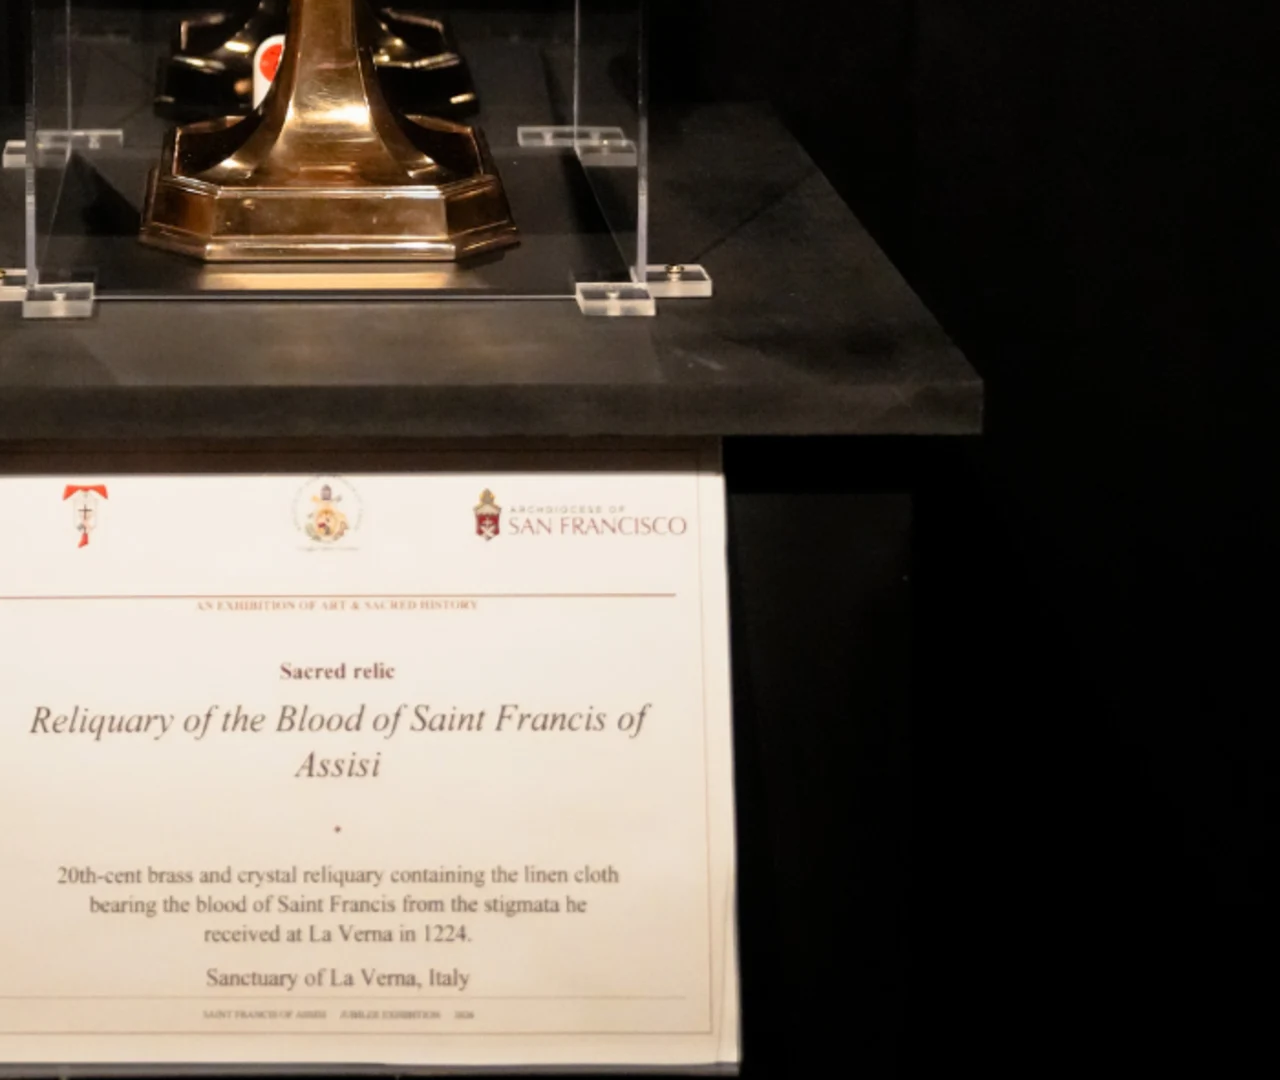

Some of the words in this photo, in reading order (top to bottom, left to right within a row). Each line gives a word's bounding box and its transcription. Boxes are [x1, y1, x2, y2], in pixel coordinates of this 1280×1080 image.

[508, 504, 603, 515] ARCHDIOCESE
[608, 504, 627, 515] OF
[508, 516, 553, 536] SAN
[560, 516, 688, 536] FRANCISCO
[216, 599, 296, 611] EXHIBITION
[298, 599, 317, 611] OF
[321, 599, 347, 611] ART
[350, 599, 361, 611] &
[364, 599, 418, 611] SACRED
[419, 599, 478, 611] HISTORY
[279, 662, 347, 681] Sacred
[353, 661, 396, 680] relic
[29, 705, 175, 742] Reliquary
[183, 704, 220, 741] of
[221, 704, 267, 733] the
[276, 703, 366, 733] Blood
[372, 703, 409, 740] of
[409, 703, 486, 732] Saint
[495, 703, 607, 732] Francis
[617, 702, 653, 739] of
[294, 751, 382, 779] Assisi
[57, 865, 143, 885] 20th-cent
[147, 865, 195, 885] brass
[198, 865, 233, 884] and
[236, 865, 298, 889] crystal
[302, 865, 384, 889] reliquary
[389, 864, 486, 889] containing
[490, 865, 519, 884] the
[524, 864, 569, 884] linen
[573, 864, 620, 884] cloth
[89, 895, 158, 919] bearing
[162, 894, 191, 914] the
[195, 894, 248, 914] blood
[252, 894, 274, 914] of
[276, 894, 325, 914] Saint
[329, 894, 397, 914] Francis
[402, 894, 446, 913] from
[450, 894, 479, 913] the
[483, 894, 561, 918] stigmata
[565, 895, 588, 914] he
[203, 924, 281, 944] received
[285, 926, 303, 944] at
[308, 924, 333, 944] La
[337, 924, 394, 943] Verna
[399, 924, 417, 943] in
[424, 924, 472, 943] 1224.
[206, 967, 298, 992] Sanctuary
[303, 967, 327, 987] of
[330, 967, 356, 988] La
[360, 967, 423, 990] Verna,
[428, 967, 470, 992] Italy
